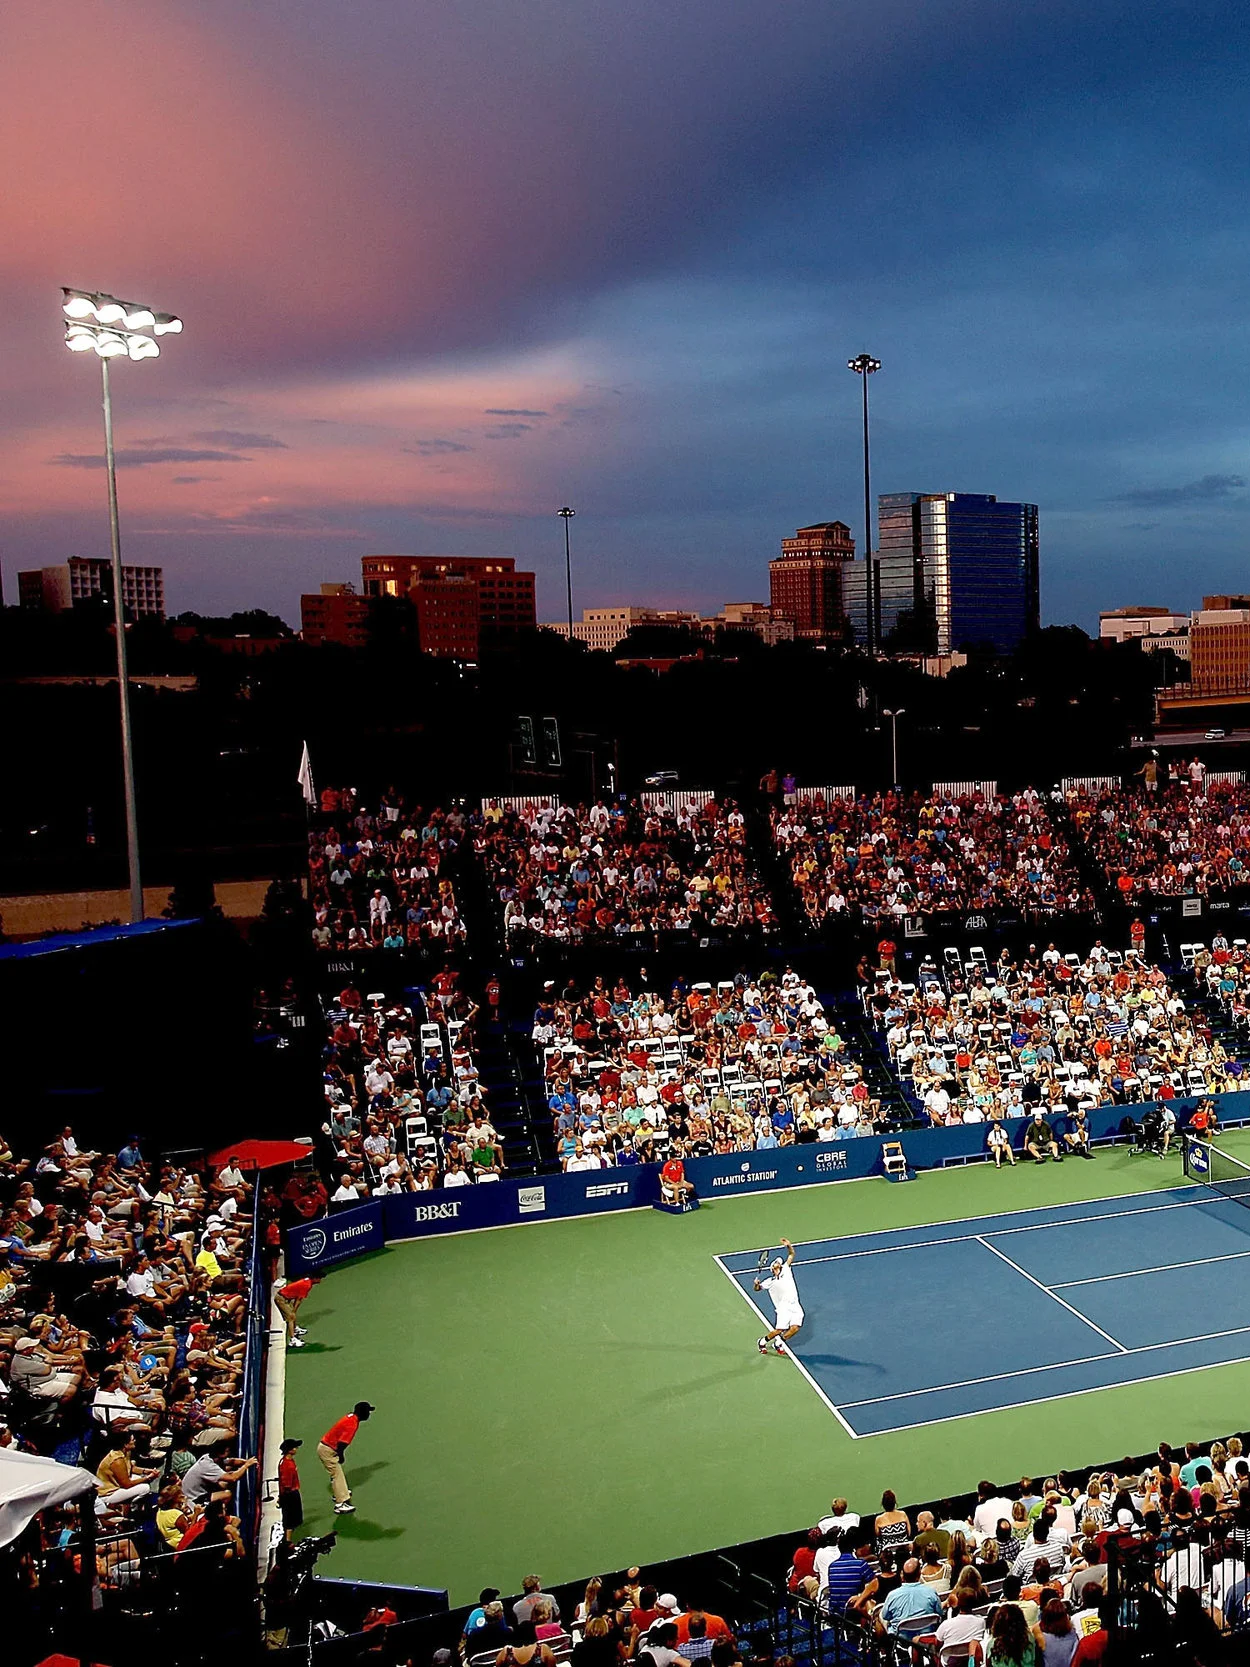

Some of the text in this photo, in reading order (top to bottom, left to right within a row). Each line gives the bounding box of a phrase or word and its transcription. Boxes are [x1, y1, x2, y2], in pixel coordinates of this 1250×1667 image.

[816, 1151, 847, 1162] CBRE
[816, 1160, 847, 1169] GLOBAL
[712, 1173, 746, 1187] ATLANTIC
[586, 1182, 629, 1198] ESPN
[415, 1202, 461, 1222] BB&T
[333, 1222, 373, 1242] Emirates
